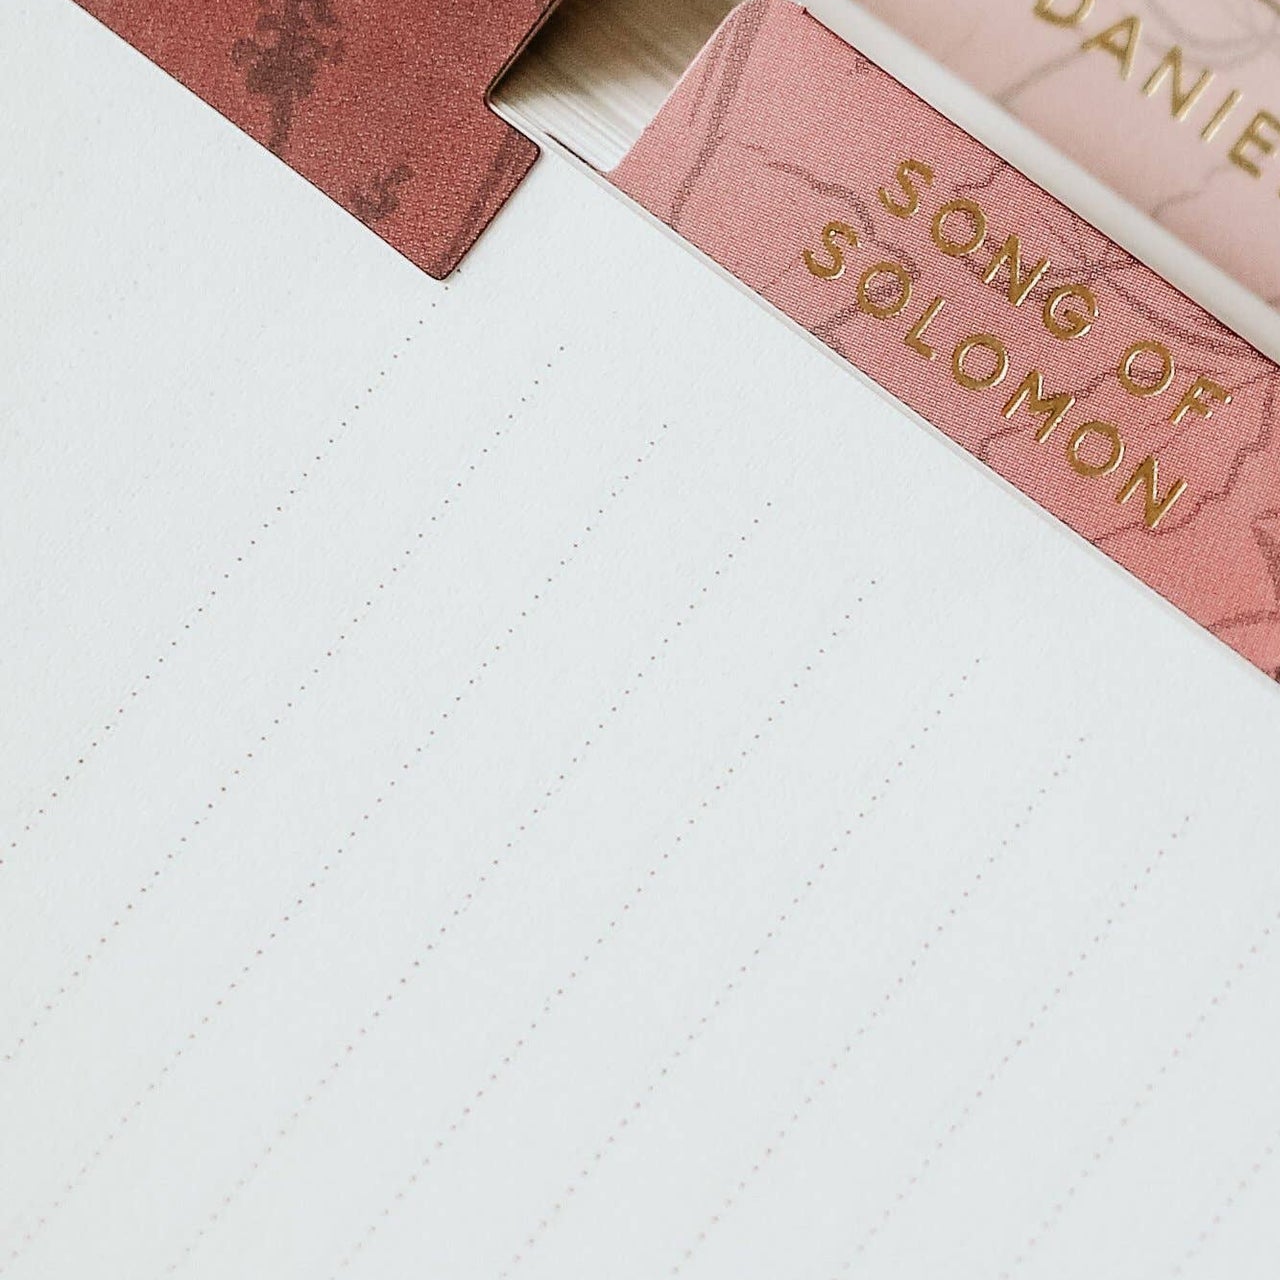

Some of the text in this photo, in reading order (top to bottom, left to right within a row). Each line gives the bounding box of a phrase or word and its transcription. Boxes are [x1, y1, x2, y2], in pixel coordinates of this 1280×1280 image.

[803, 220, 1188, 528] SOLOMON
[879, 158, 1233, 423] SONG OF
